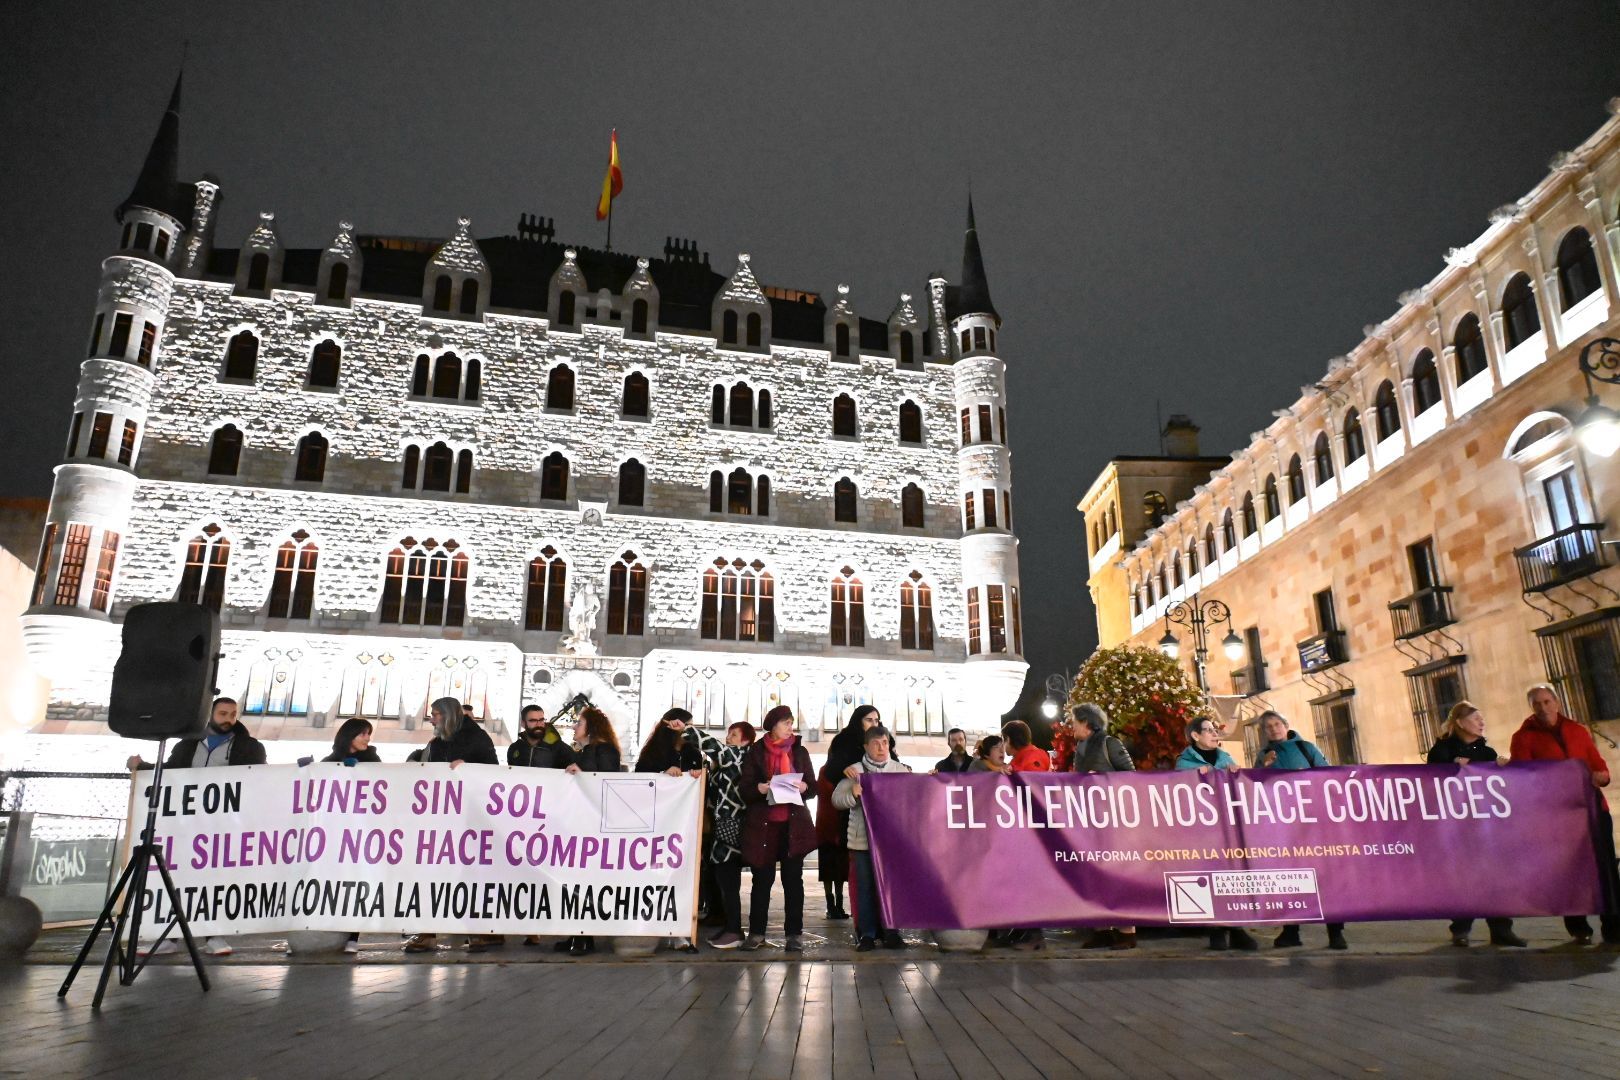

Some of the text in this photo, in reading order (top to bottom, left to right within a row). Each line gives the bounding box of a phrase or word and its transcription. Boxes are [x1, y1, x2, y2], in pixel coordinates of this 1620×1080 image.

[162, 779, 546, 820] LEON LUNES SIN SOL
[946, 770, 1512, 829] EL SILENCIO NOS HACE CÓMPLICES
[190, 826, 327, 870] SILENCIO
[338, 828, 404, 866] NOS
[416, 828, 494, 866] HACE
[505, 824, 683, 871] CÓMPLICES
[1055, 840, 1415, 862] PLATAFORMA CONTRA LA VIOLENCIA MACHISTA DE LEÓN
[291, 878, 385, 918] CONTRA
[394, 881, 421, 918] LA
[430, 881, 552, 921] VIOLENCIA
[560, 884, 678, 922] MACHISTA
[1227, 901, 1308, 911] LUNES SIN SOL
